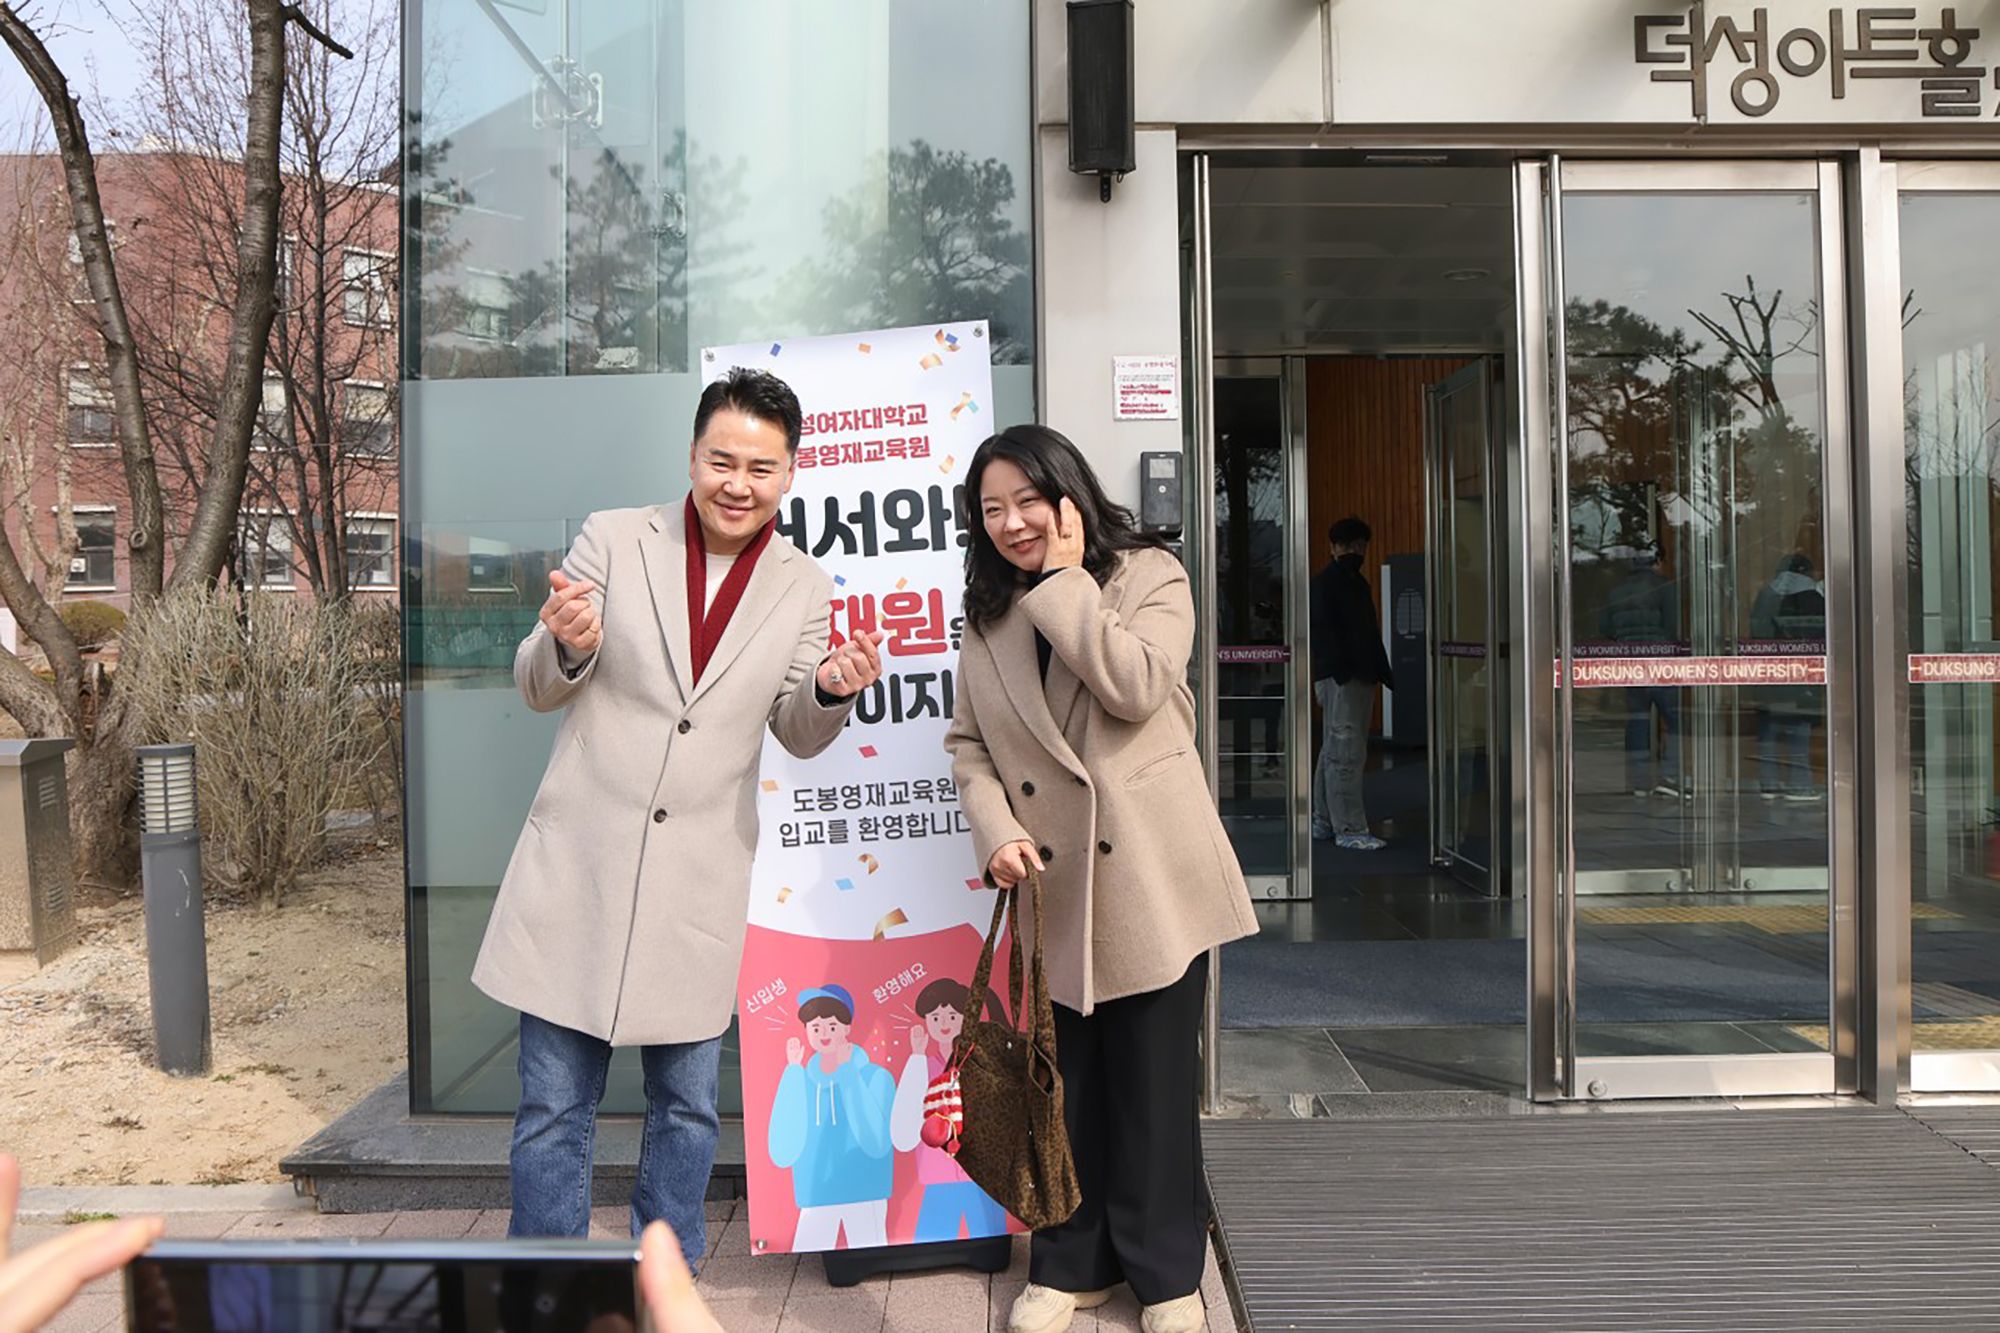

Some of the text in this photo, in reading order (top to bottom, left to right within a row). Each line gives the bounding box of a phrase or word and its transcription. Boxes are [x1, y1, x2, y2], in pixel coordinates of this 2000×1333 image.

[1634, 7, 1986, 117] 덕성아트홀
[1232, 649, 1283, 660] UNIVERSITY
[1589, 646, 1629, 655] WOMEN'S
[1632, 645, 1680, 654] UNIVERSITY
[1779, 643, 1820, 652] WOMEN'S
[1573, 663, 1808, 681] DUKSUNG WOMEN'S UNIVERSITY
[1924, 661, 1995, 676] DUKSUNG
[793, 777, 958, 813] 도봉영재교육원
[779, 818, 850, 848] 입교를
[872, 962, 927, 1004] 환영해요
[745, 977, 788, 1014] 신입생
